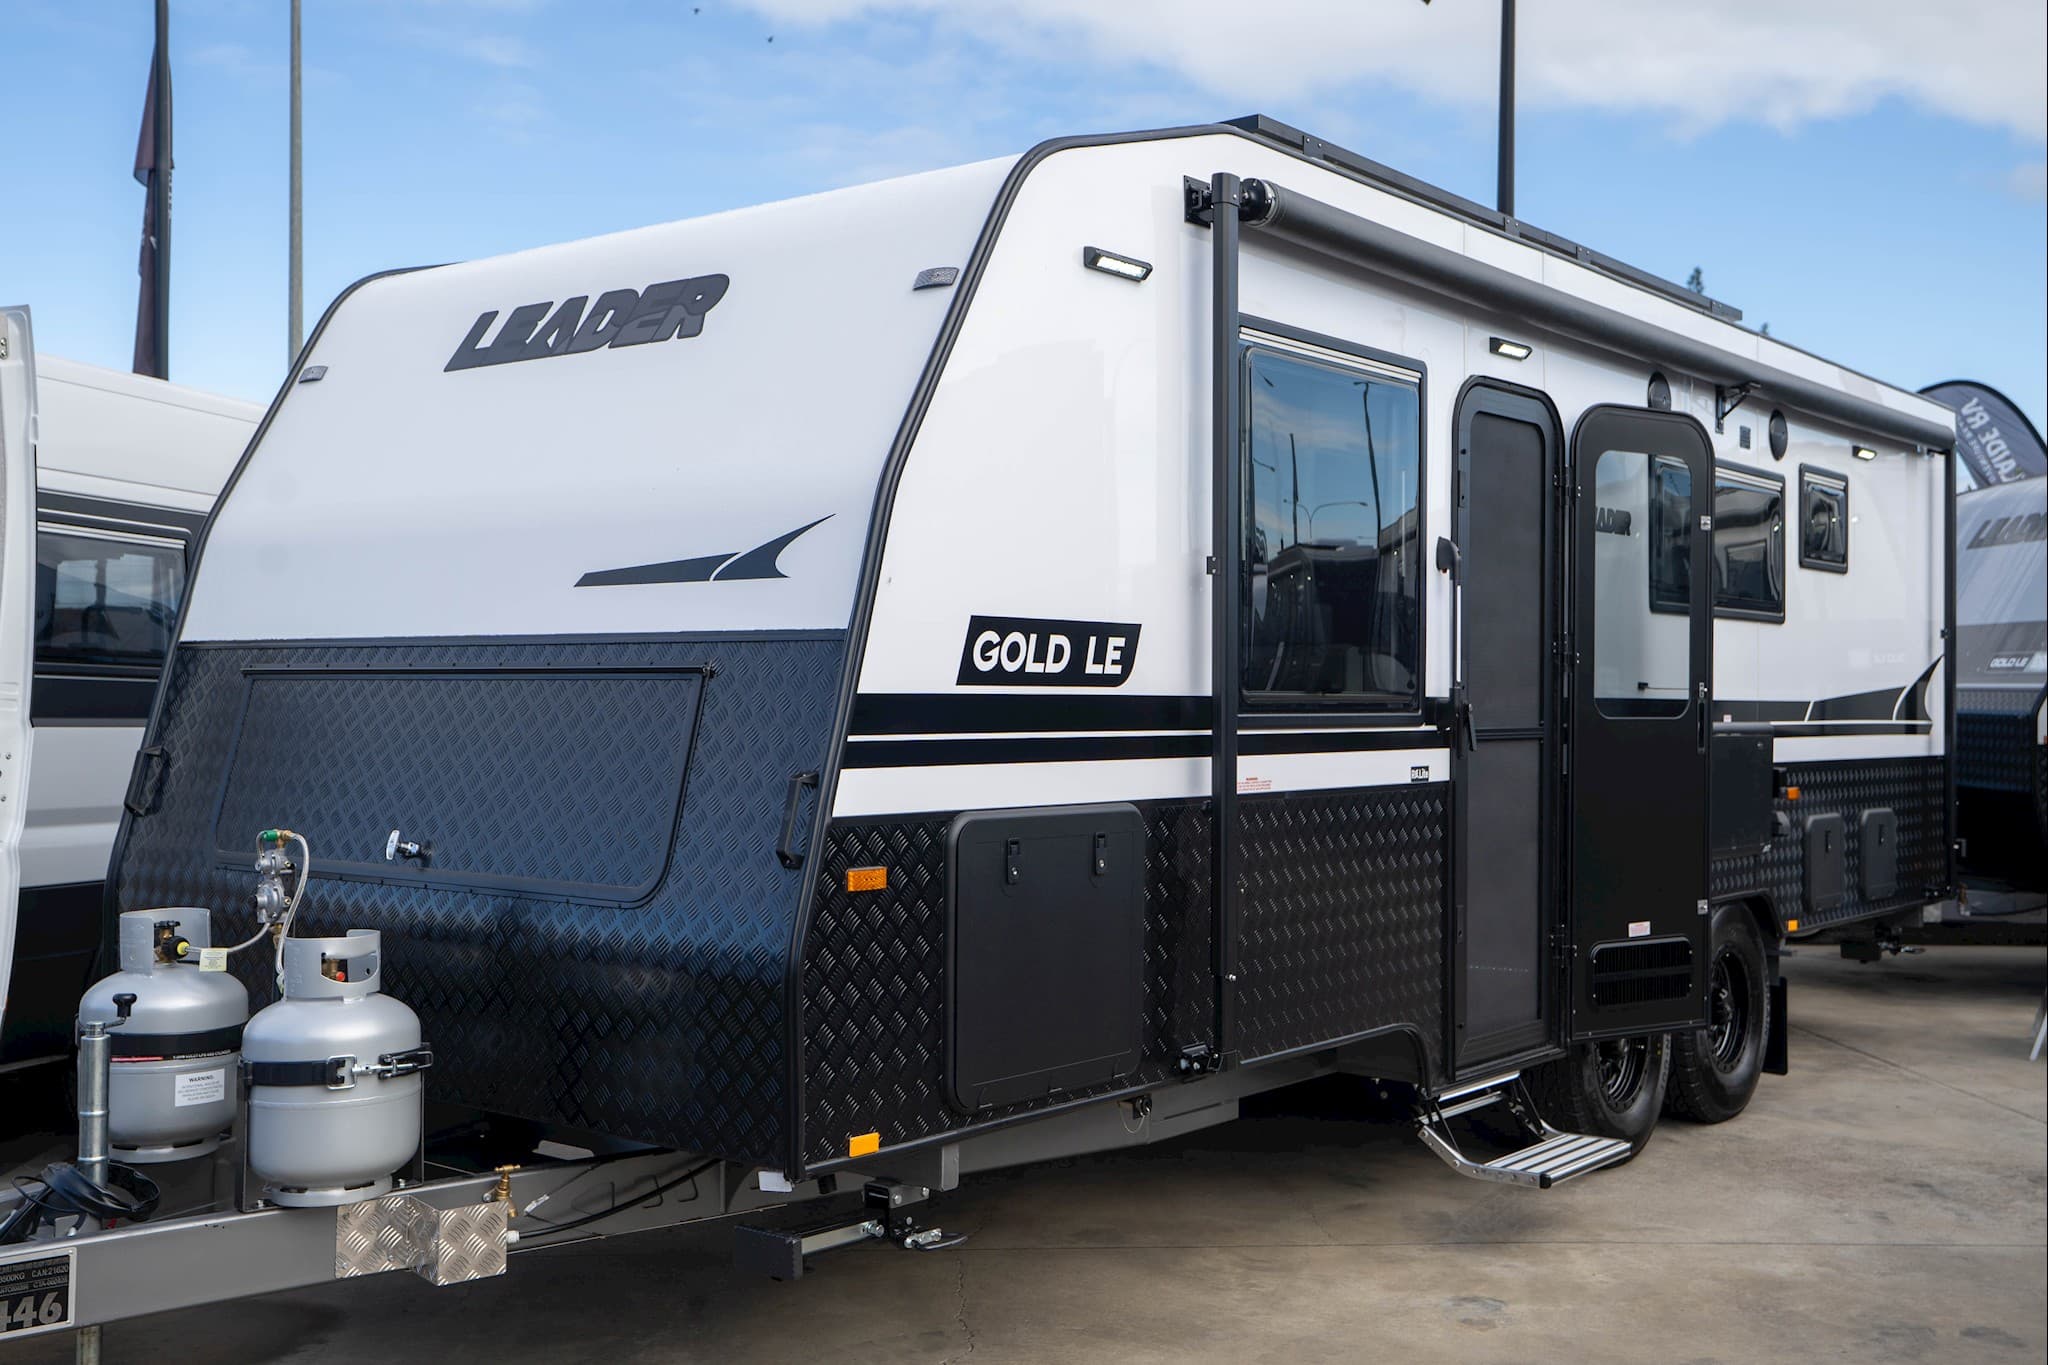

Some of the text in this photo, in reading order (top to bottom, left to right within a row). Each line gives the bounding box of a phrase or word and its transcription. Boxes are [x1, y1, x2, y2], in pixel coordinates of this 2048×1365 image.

[444, 273, 730, 372] LEADER
[972, 630, 1127, 675] GOLD LE
